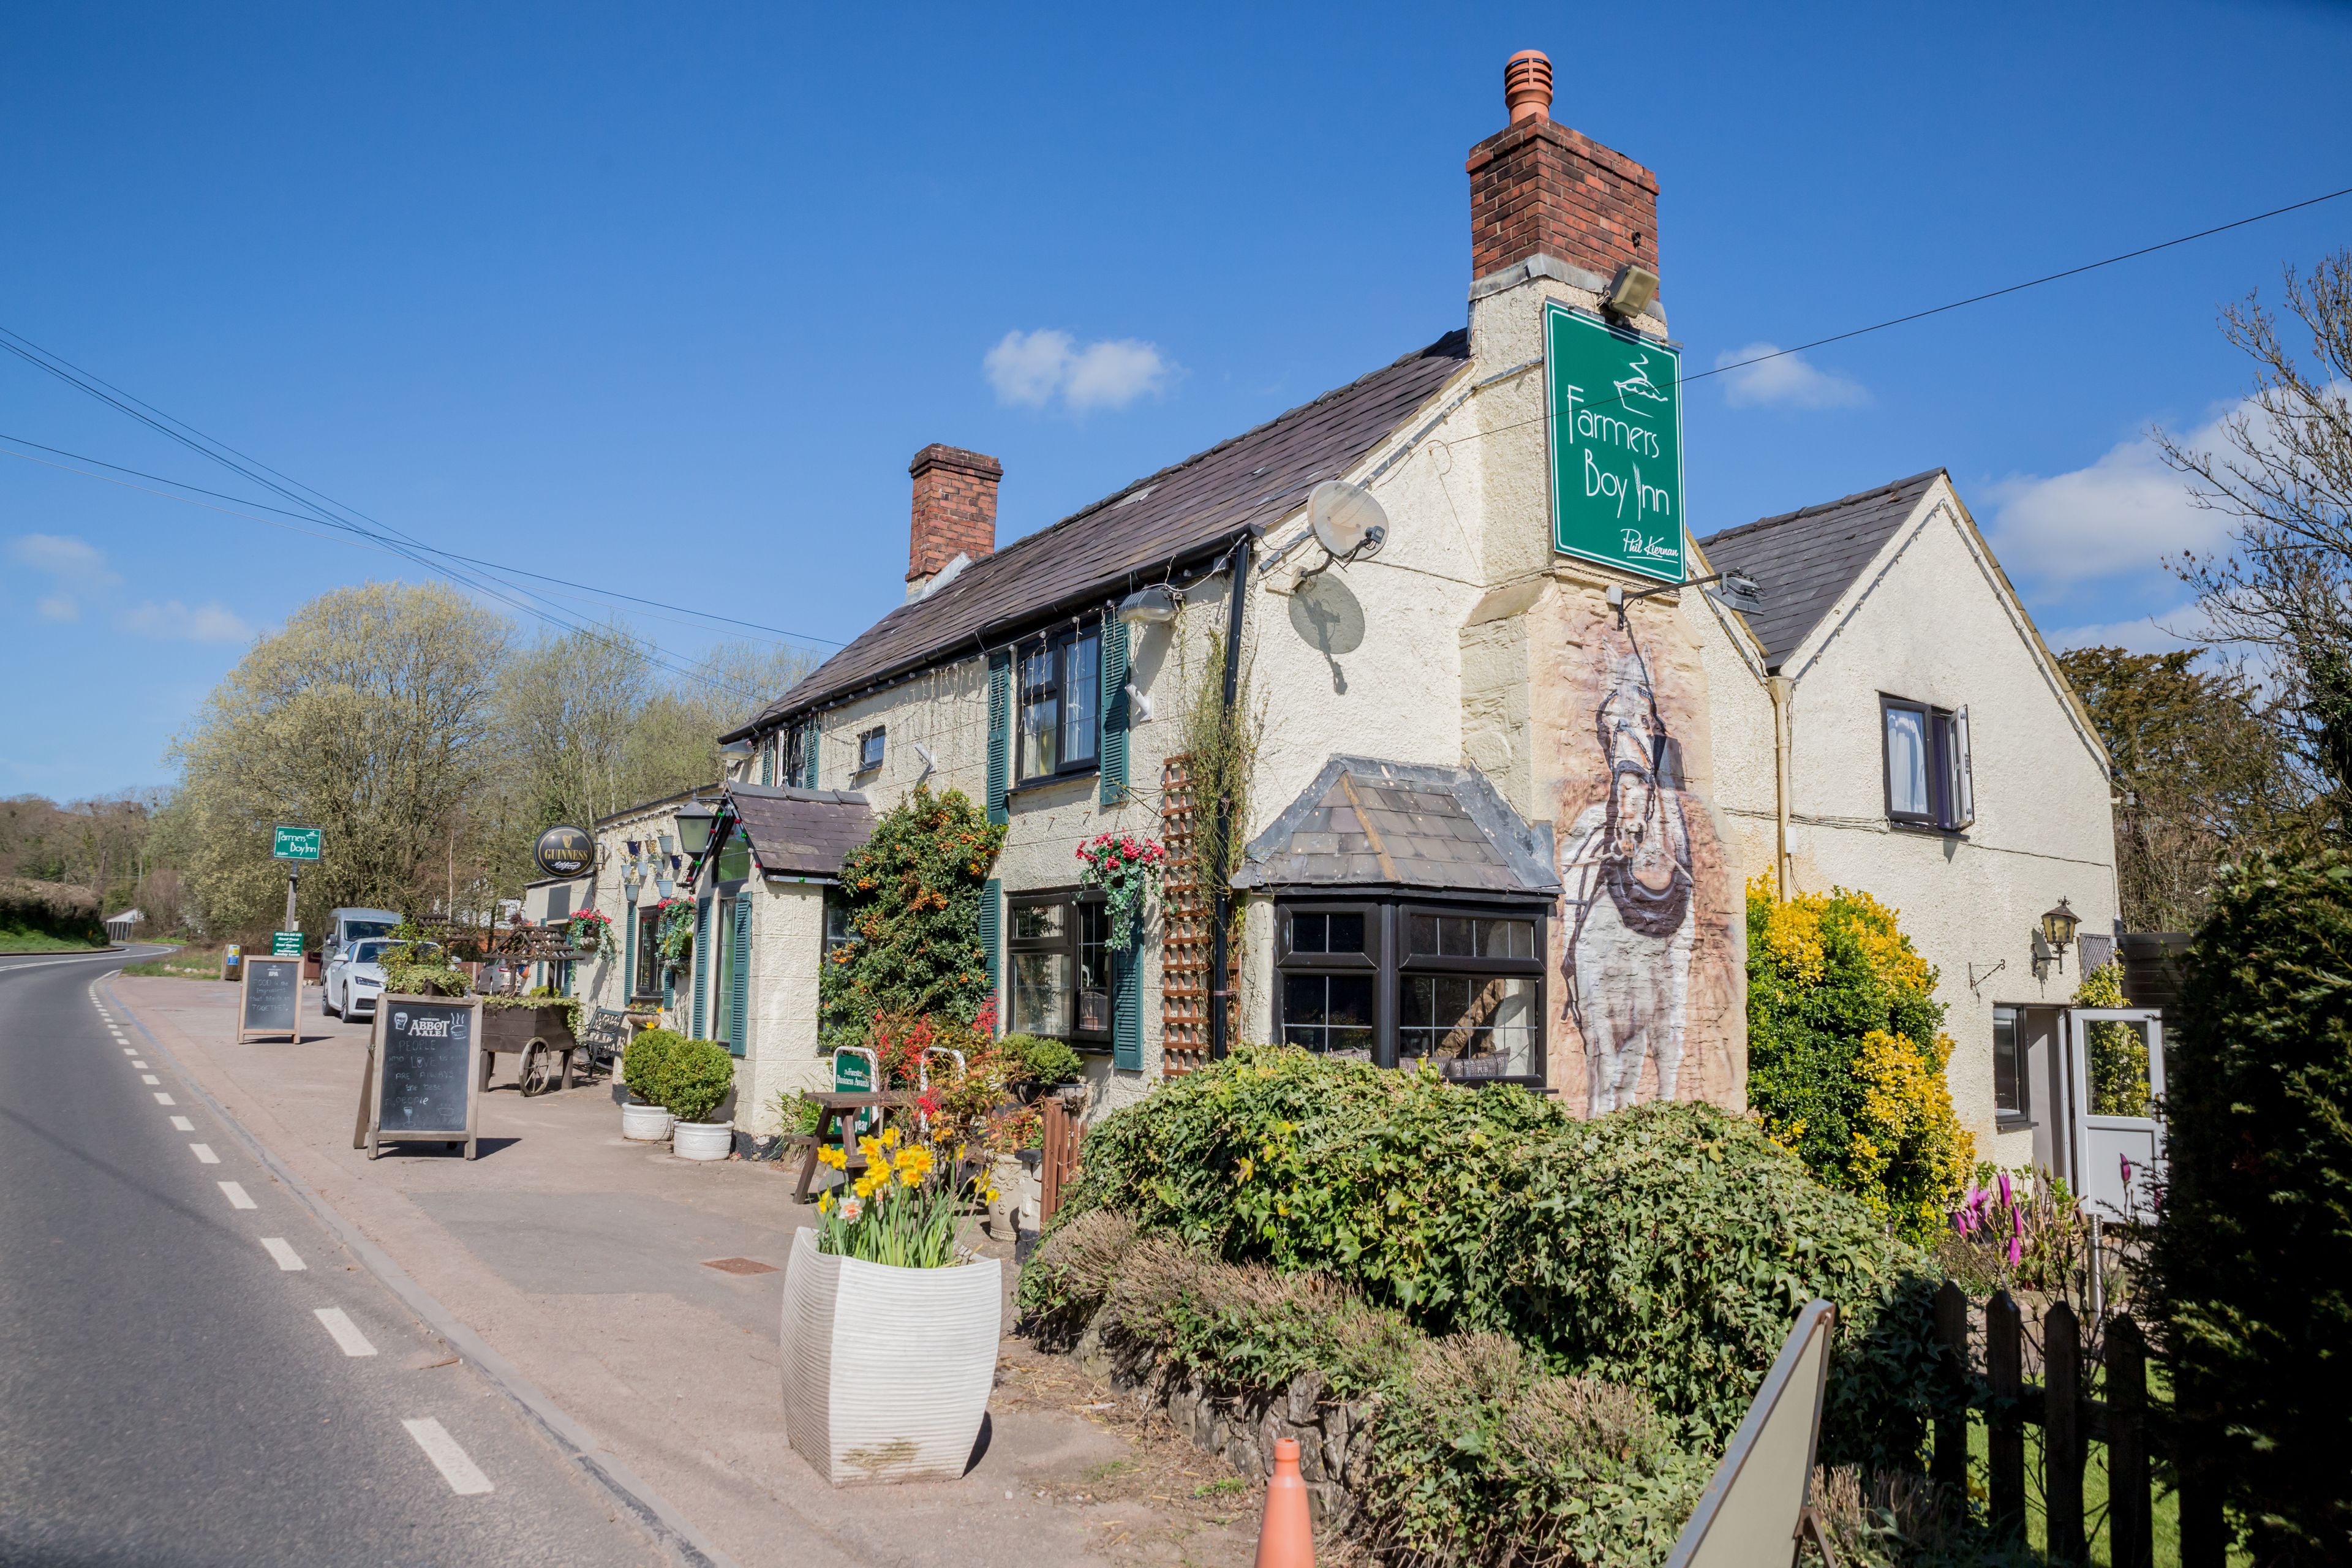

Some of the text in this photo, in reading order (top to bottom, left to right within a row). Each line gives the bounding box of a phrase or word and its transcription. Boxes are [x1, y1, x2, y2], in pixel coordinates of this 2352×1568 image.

[1567, 385, 1659, 458] Farmers
[1585, 448, 1669, 521] Boy Inn
[1620, 529, 1679, 558] Phil Kiernan
[277, 831, 306, 843] Farmers
[290, 842, 317, 856] Boy Inn
[545, 848, 588, 861] GUINNESS
[408, 1019, 450, 1037] ABBOT
[399, 1039, 437, 1052] PEOPLE
[410, 1056, 437, 1068] LOVE
[837, 1074, 870, 1087] Business Awards
[854, 1120, 868, 1133] year
